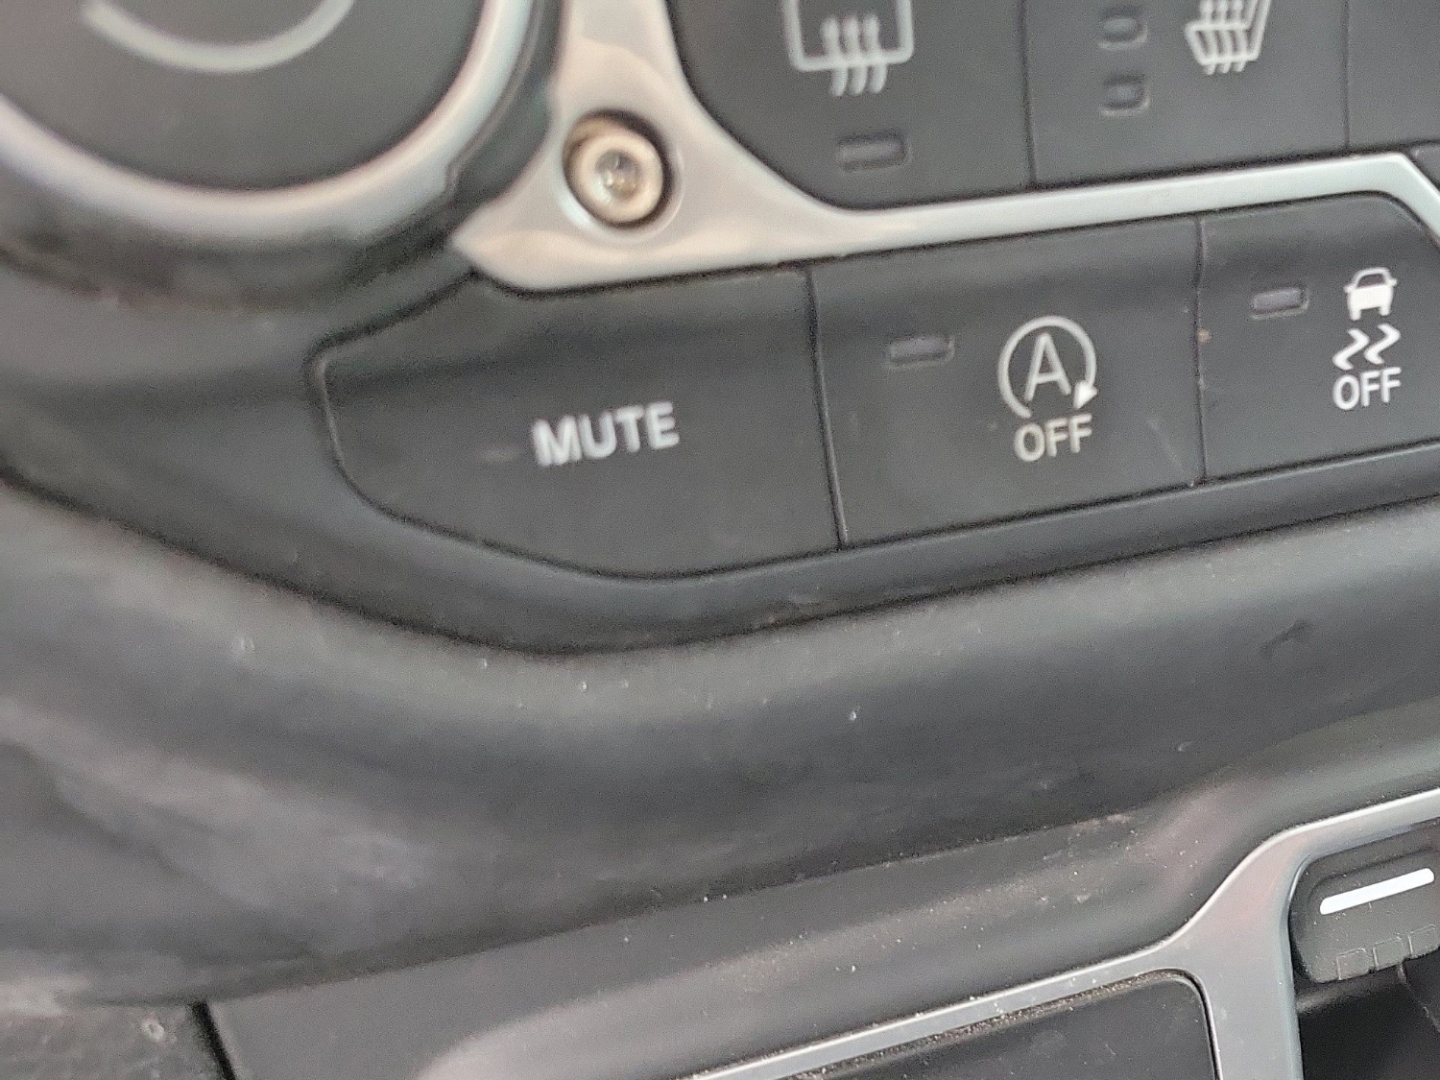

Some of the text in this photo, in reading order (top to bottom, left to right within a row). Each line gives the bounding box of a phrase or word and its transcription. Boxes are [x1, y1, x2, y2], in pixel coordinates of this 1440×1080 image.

[1332, 367, 1401, 410] OFF
[532, 401, 680, 467] MUTE
[1013, 413, 1092, 462] OFF
